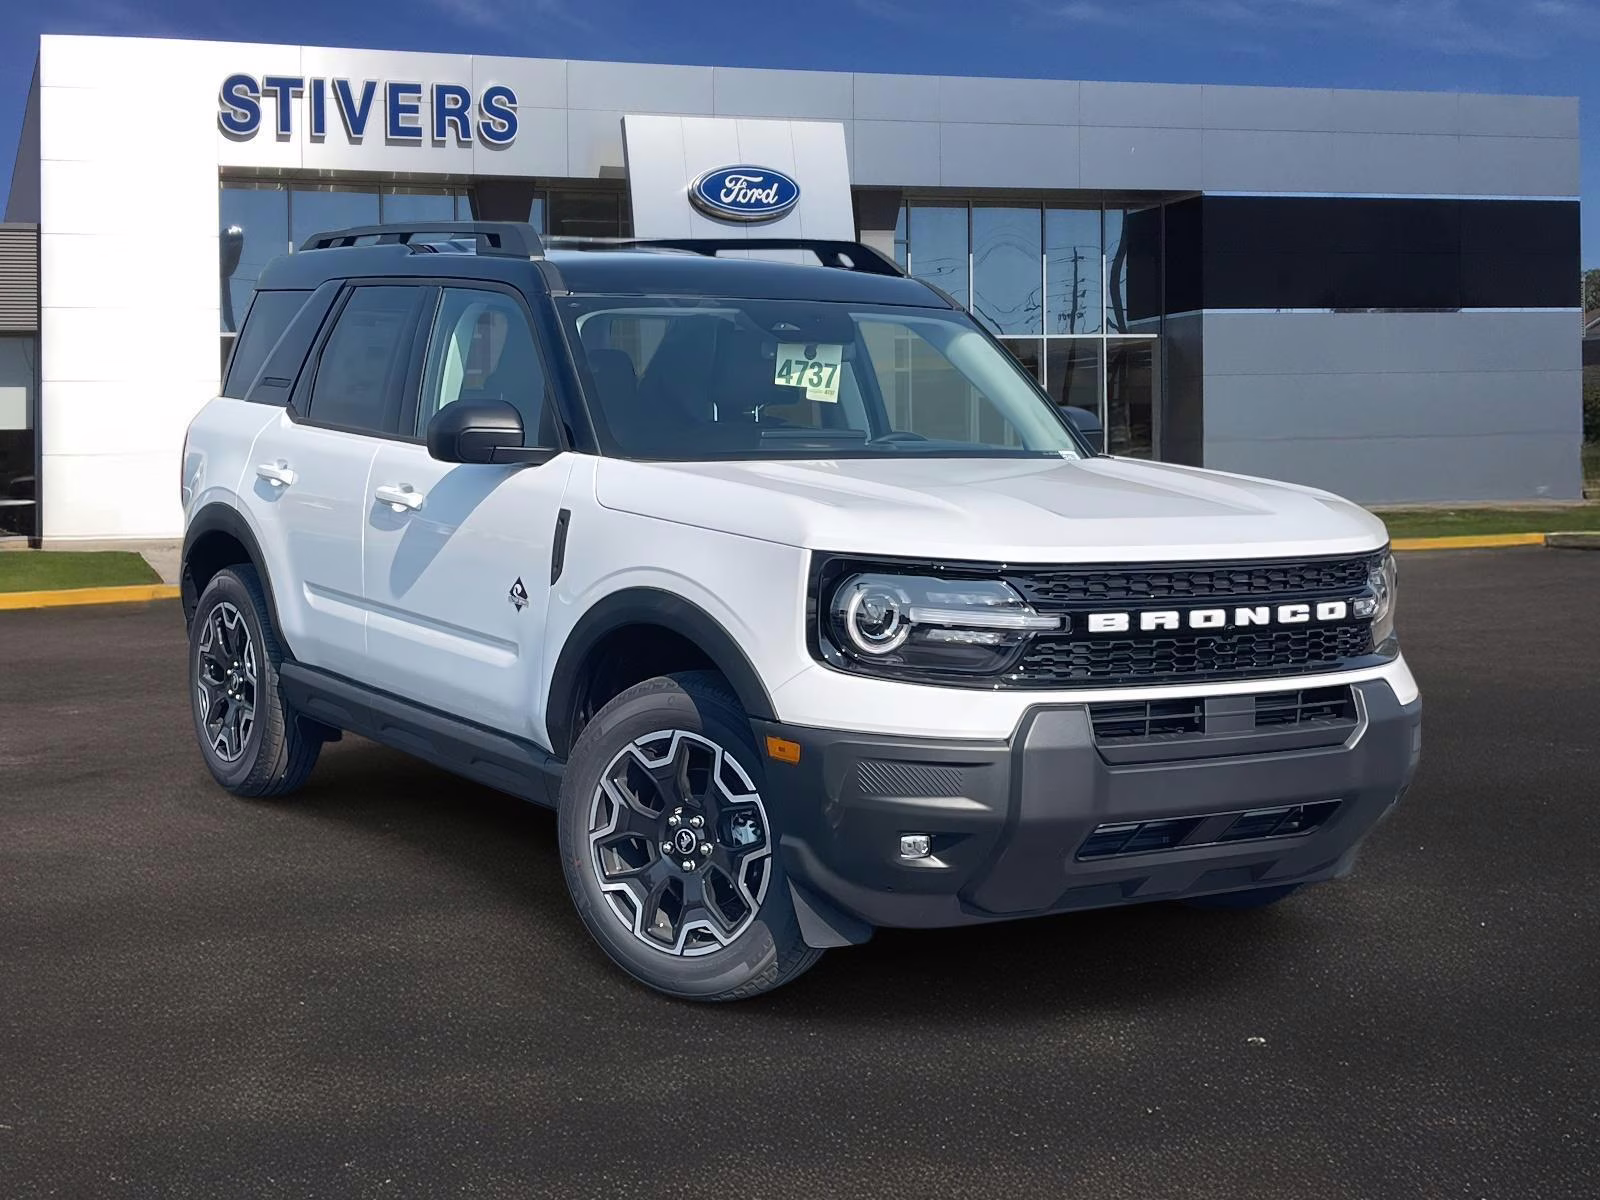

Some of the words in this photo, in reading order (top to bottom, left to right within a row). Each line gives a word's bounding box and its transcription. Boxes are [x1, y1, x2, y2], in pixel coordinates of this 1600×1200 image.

[218, 72, 519, 147] STIVERS
[720, 174, 779, 204] Ford
[777, 359, 838, 389] 4737
[1088, 601, 1347, 633] BRONCO
